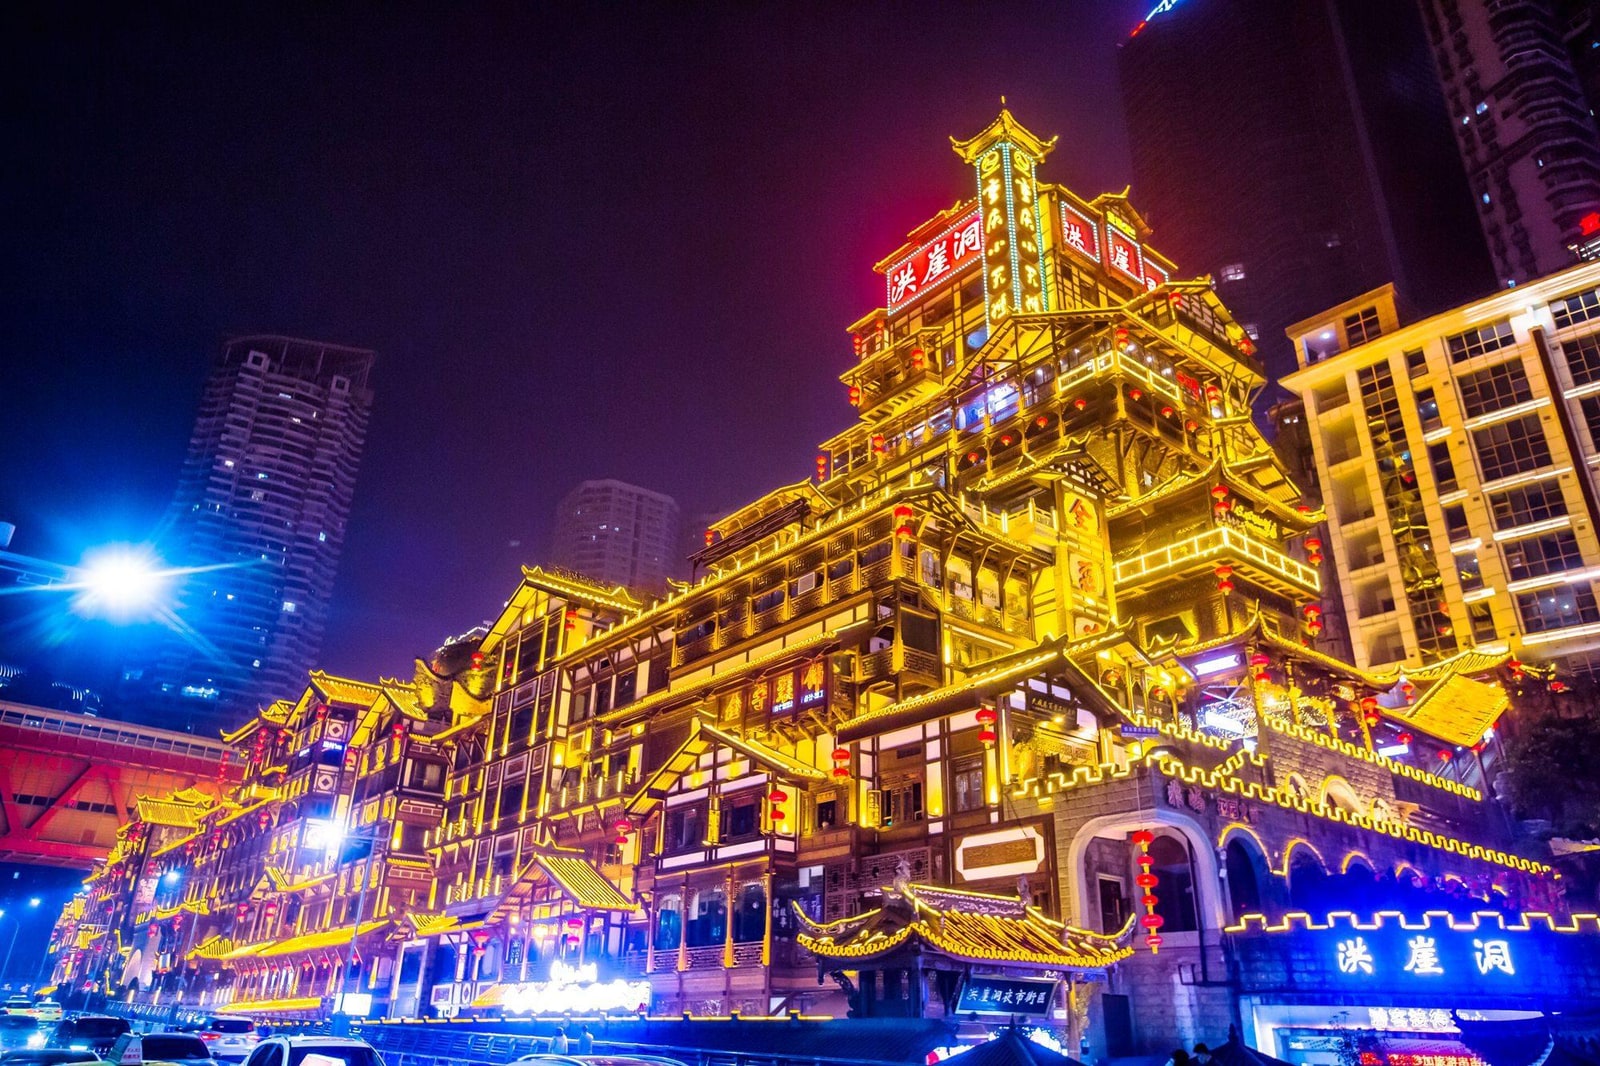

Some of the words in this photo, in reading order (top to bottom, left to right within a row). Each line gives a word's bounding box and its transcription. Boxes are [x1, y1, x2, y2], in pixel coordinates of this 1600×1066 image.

[891, 220, 981, 303] 洪崖洞
[1337, 936, 1515, 975] 洪崖洞
[966, 987, 1047, 1005] 洪崖洞夜市街区
